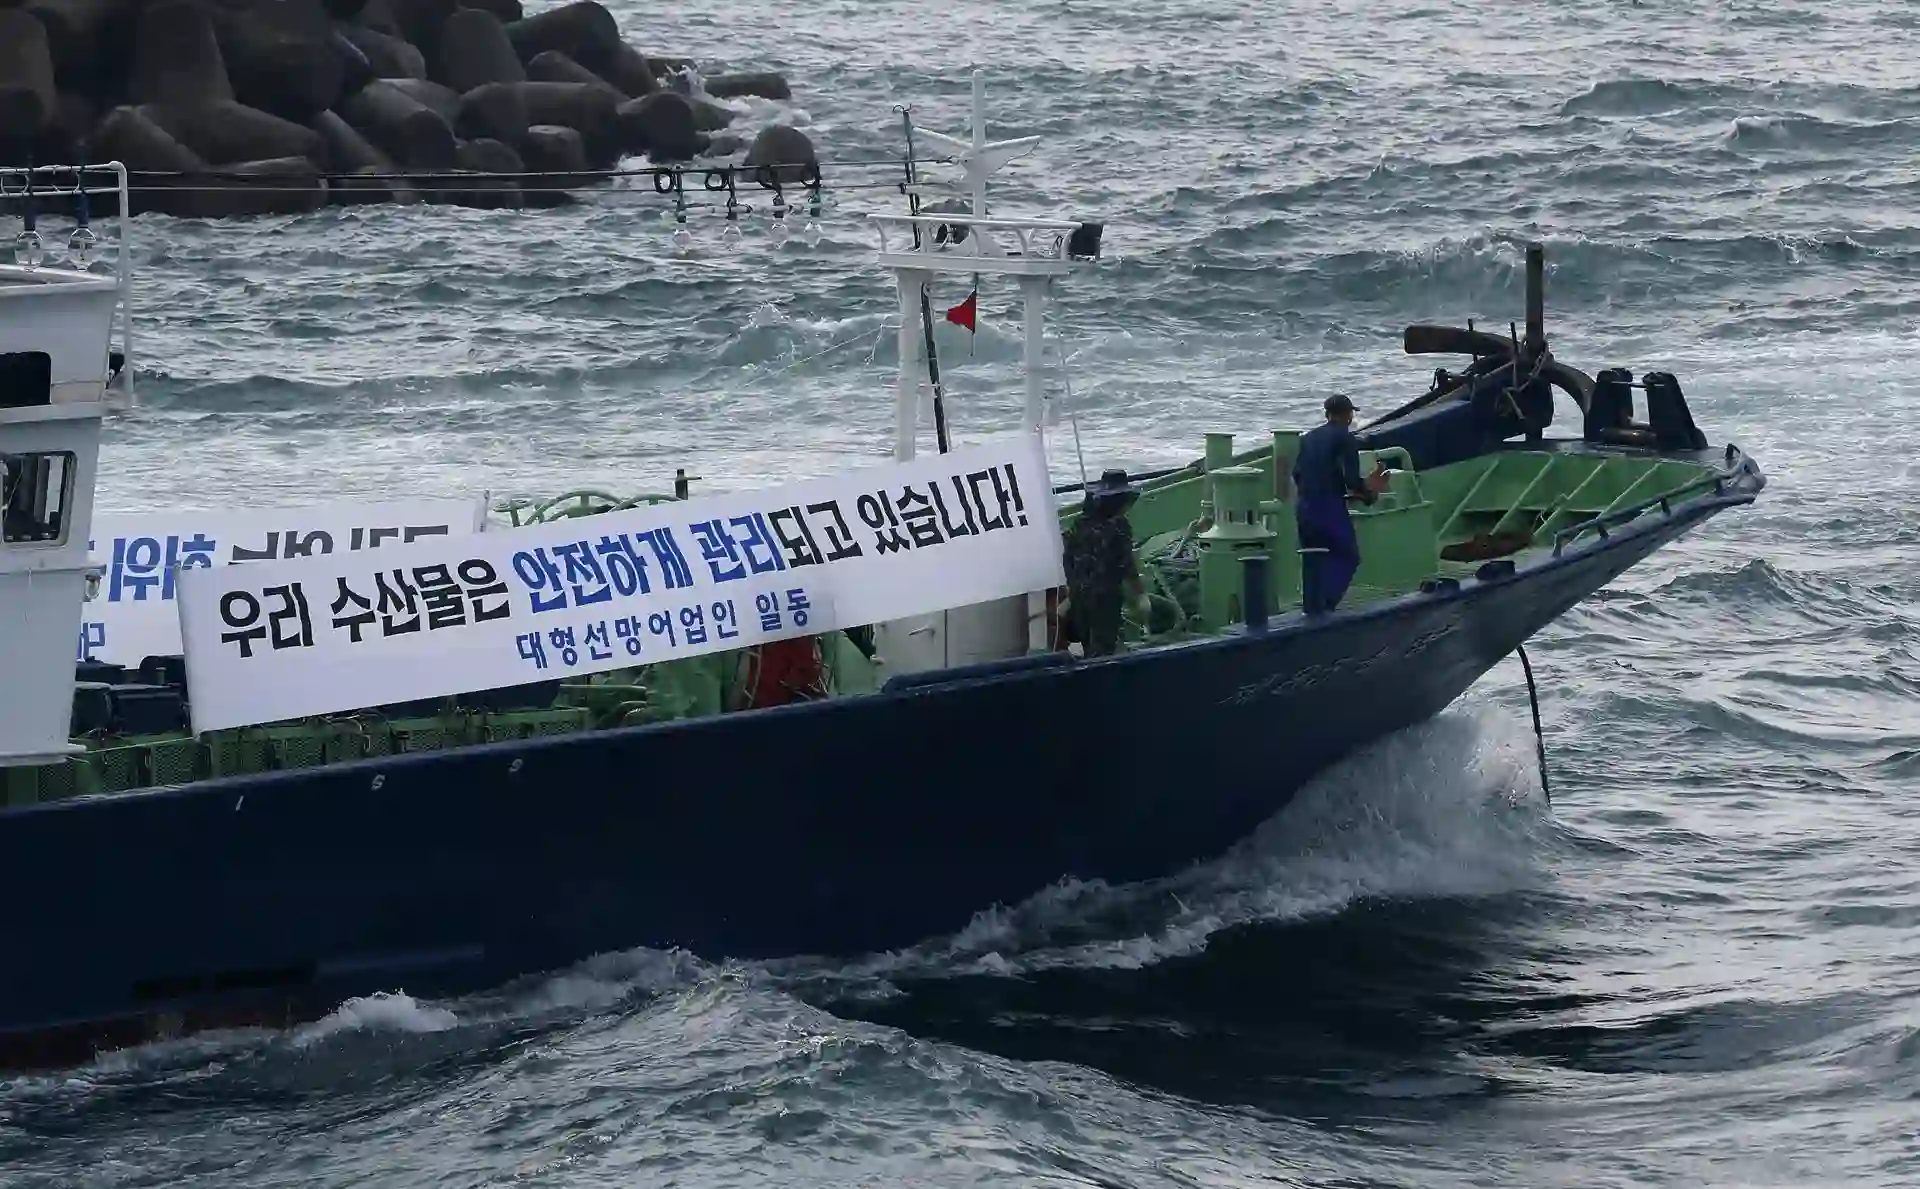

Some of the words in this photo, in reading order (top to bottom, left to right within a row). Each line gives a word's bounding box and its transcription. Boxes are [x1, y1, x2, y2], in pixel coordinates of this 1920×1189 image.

[220, 582, 314, 658] 우리
[330, 558, 510, 644] 수산물은
[511, 526, 694, 614] 안전하게
[689, 500, 864, 583] 관리되고
[856, 463, 1029, 556] 있습니다!
[515, 600, 740, 671] 대형선망어업인
[755, 587, 812, 632] 일동
